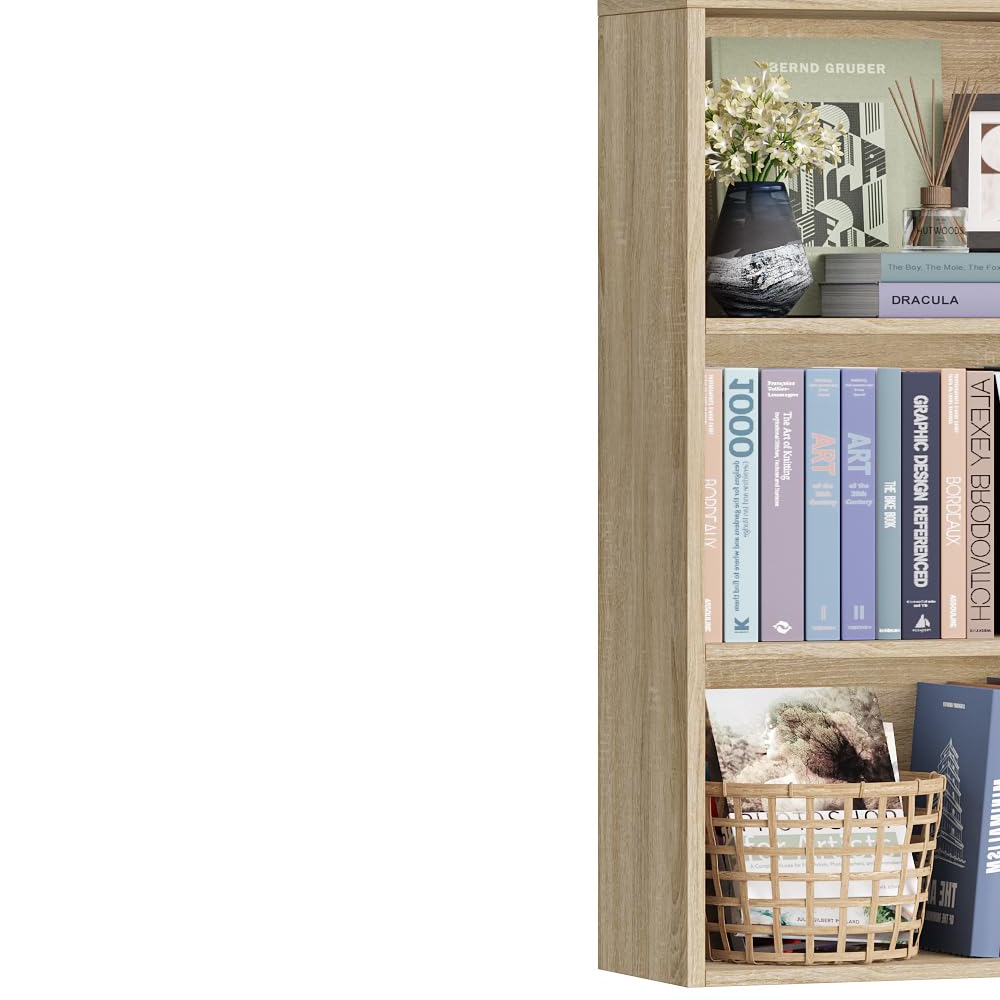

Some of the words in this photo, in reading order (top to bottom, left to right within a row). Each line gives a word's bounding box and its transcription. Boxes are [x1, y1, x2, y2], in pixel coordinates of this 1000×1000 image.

[769, 62, 820, 73] BERND
[825, 63, 886, 74] GRUBER
[892, 296, 959, 305] DRACULA
[783, 411, 792, 426] The
[913, 395, 929, 452] GRAPHIC
[783, 428, 792, 440] Art
[783, 441, 792, 449] of
[811, 432, 836, 476] ART
[847, 432, 871, 476] ART
[780, 450, 792, 480] Knitting
[913, 455, 929, 501] DESIGN
[884, 481, 896, 493] THE
[884, 495, 896, 510] BIKE
[945, 476, 961, 545] BORDEAUX
[884, 512, 896, 529] BOOK
[913, 505, 929, 588] REFERENCED
